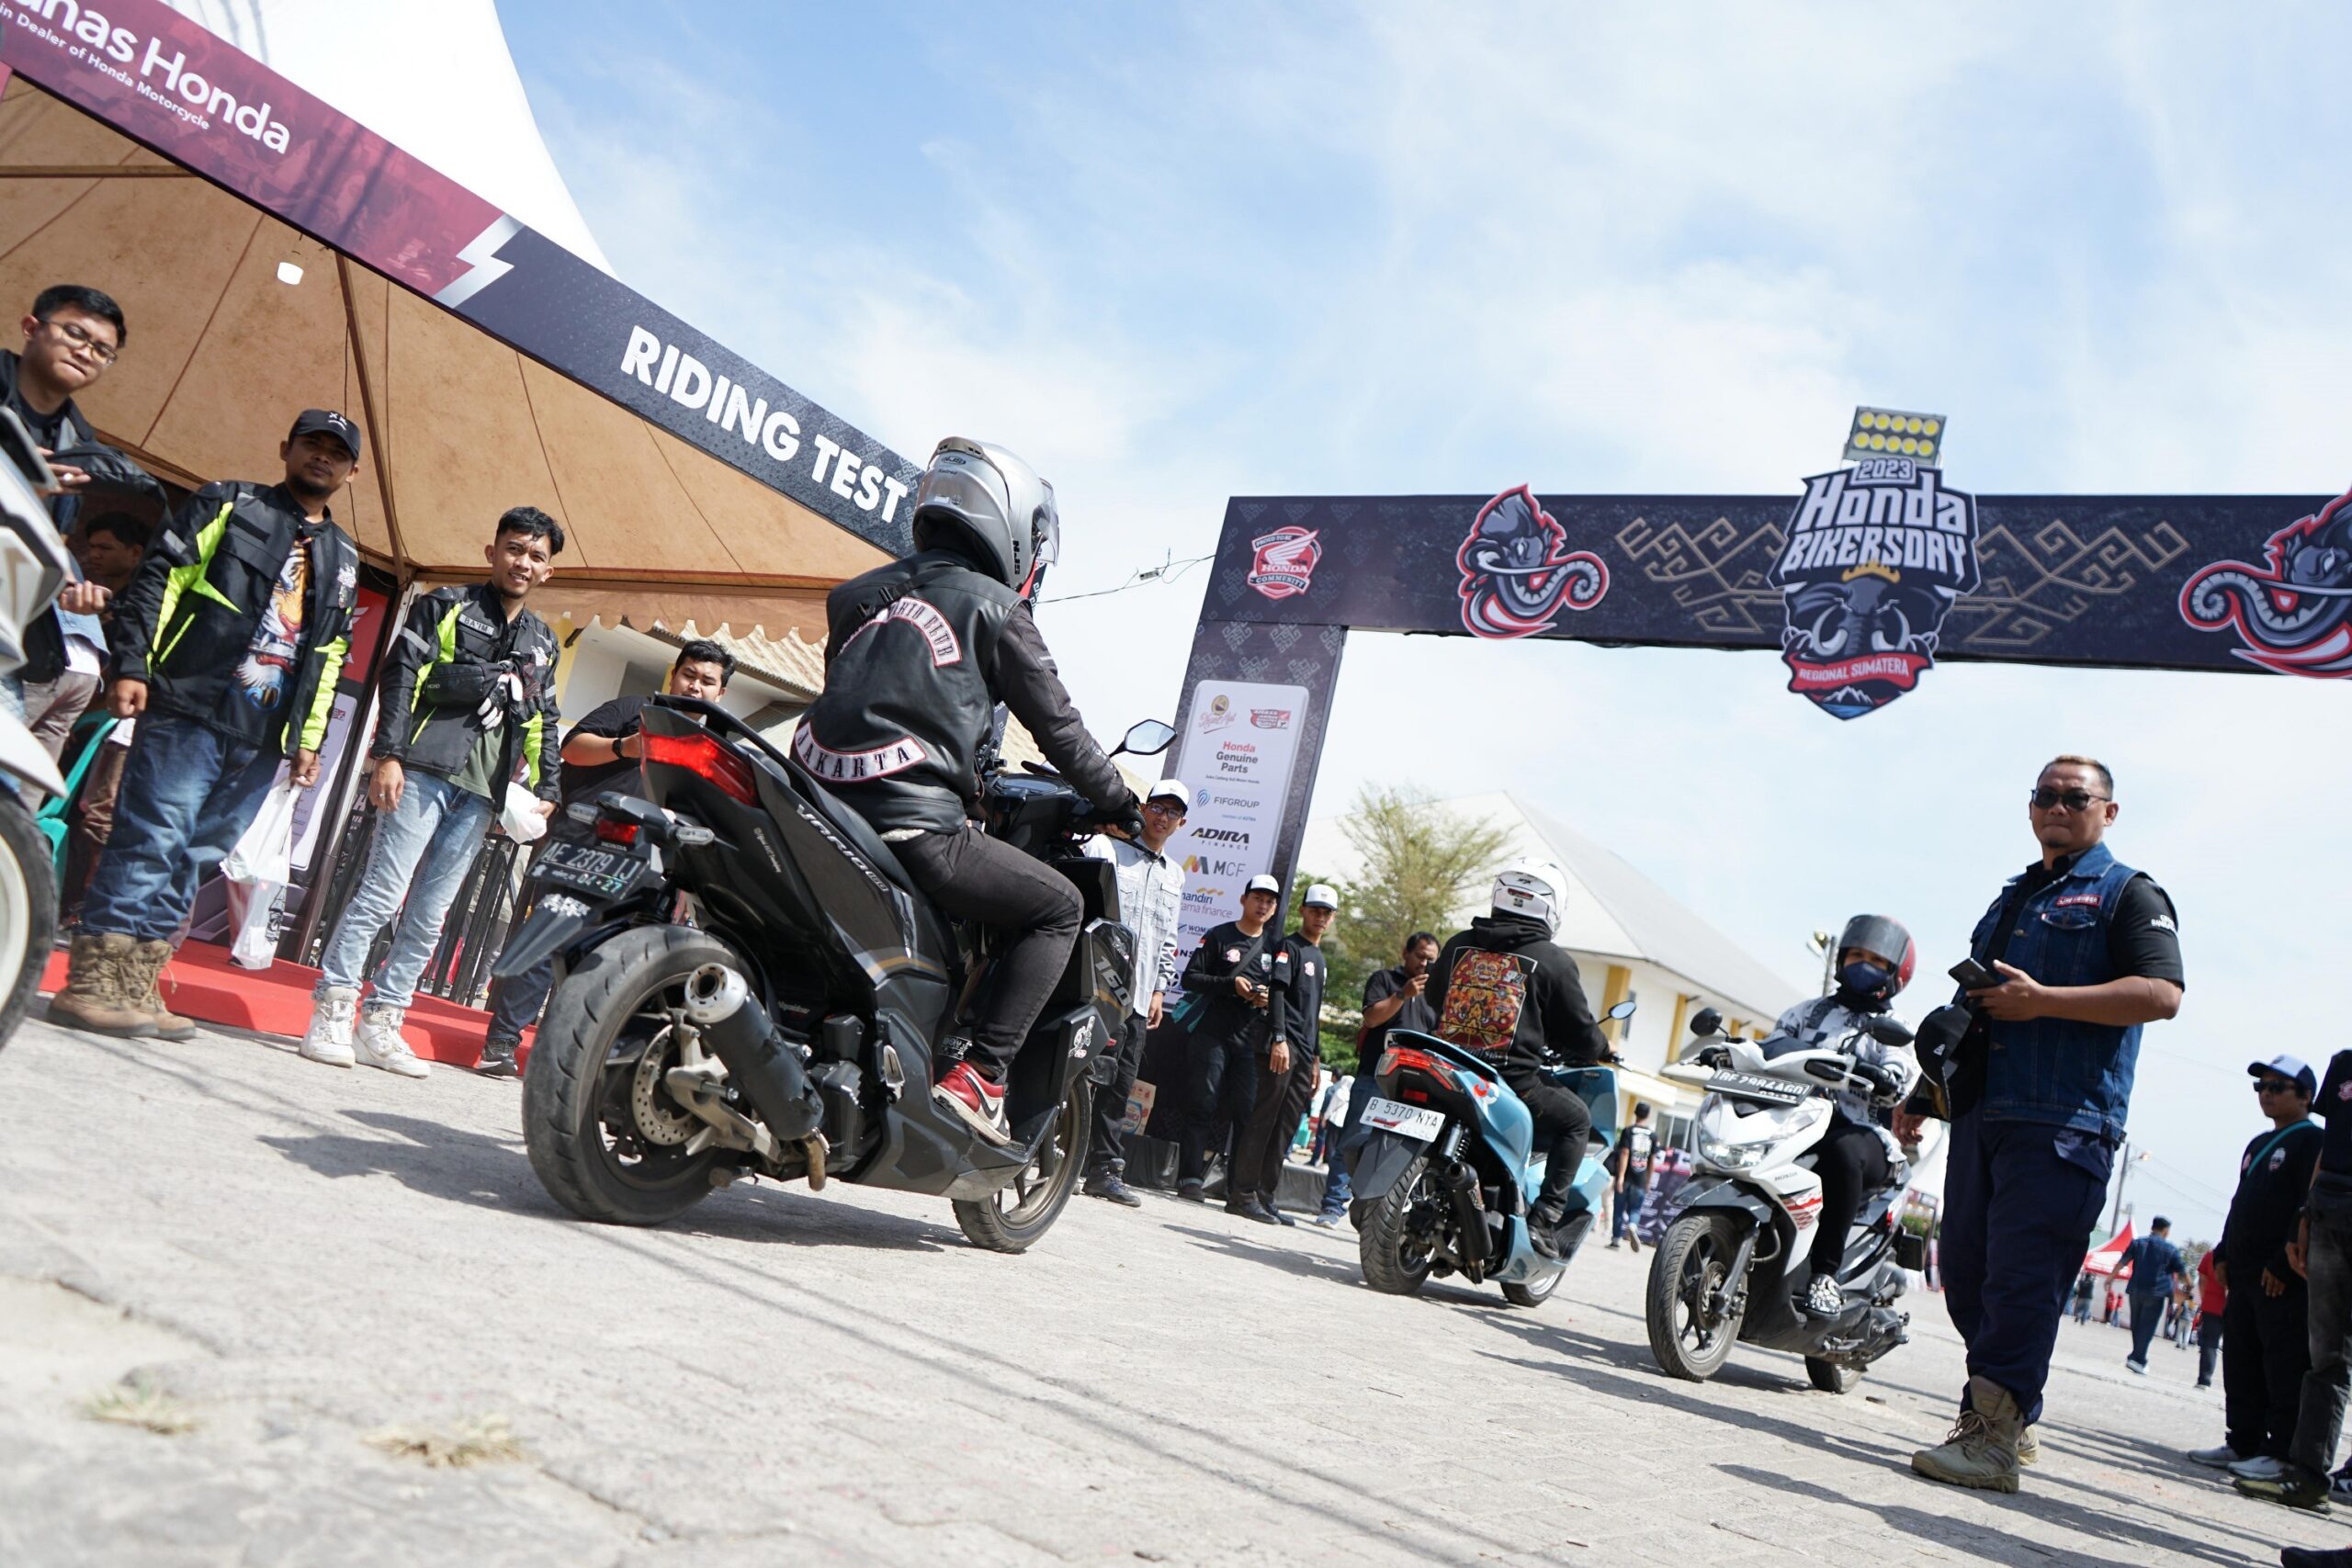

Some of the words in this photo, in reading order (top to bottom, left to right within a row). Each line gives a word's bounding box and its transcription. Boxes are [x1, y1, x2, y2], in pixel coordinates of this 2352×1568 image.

[17, 12, 67, 48] Dealer
[69, 46, 87, 60] of
[88, 52, 134, 87] Honda
[137, 81, 210, 130] Motorcycle
[141, 37, 291, 154] Honda
[620, 325, 801, 461] RIDING
[811, 434, 908, 523] TEST
[1860, 458, 1913, 480] 2023
[1795, 470, 1968, 536] Honda
[1780, 526, 1968, 585] BIKERSDAY
[1261, 564, 1308, 573] HONDA
[1255, 575, 1306, 588] COMMUNITY
[1798, 667, 1849, 682] REGIONAL
[1850, 659, 1909, 677] SUMATERA
[797, 730, 911, 779] JAKARTA
[1216, 751, 1259, 763] Genuine
[1223, 740, 1256, 753] Honda
[1220, 762, 1249, 773] Parts
[1214, 796, 1261, 808] FIFGROUP
[1191, 828, 1250, 844] ADIRA
[1201, 840, 1249, 851] FINANCE
[540, 842, 571, 863] AE
[566, 848, 615, 873] 2379
[1214, 860, 1247, 878] MCF
[1201, 904, 1233, 919] finance
[1095, 955, 1132, 1007] 160
[1369, 1100, 1379, 1110] B
[1384, 1103, 1413, 1120] 5370
[1416, 1111, 1438, 1127] NYA
